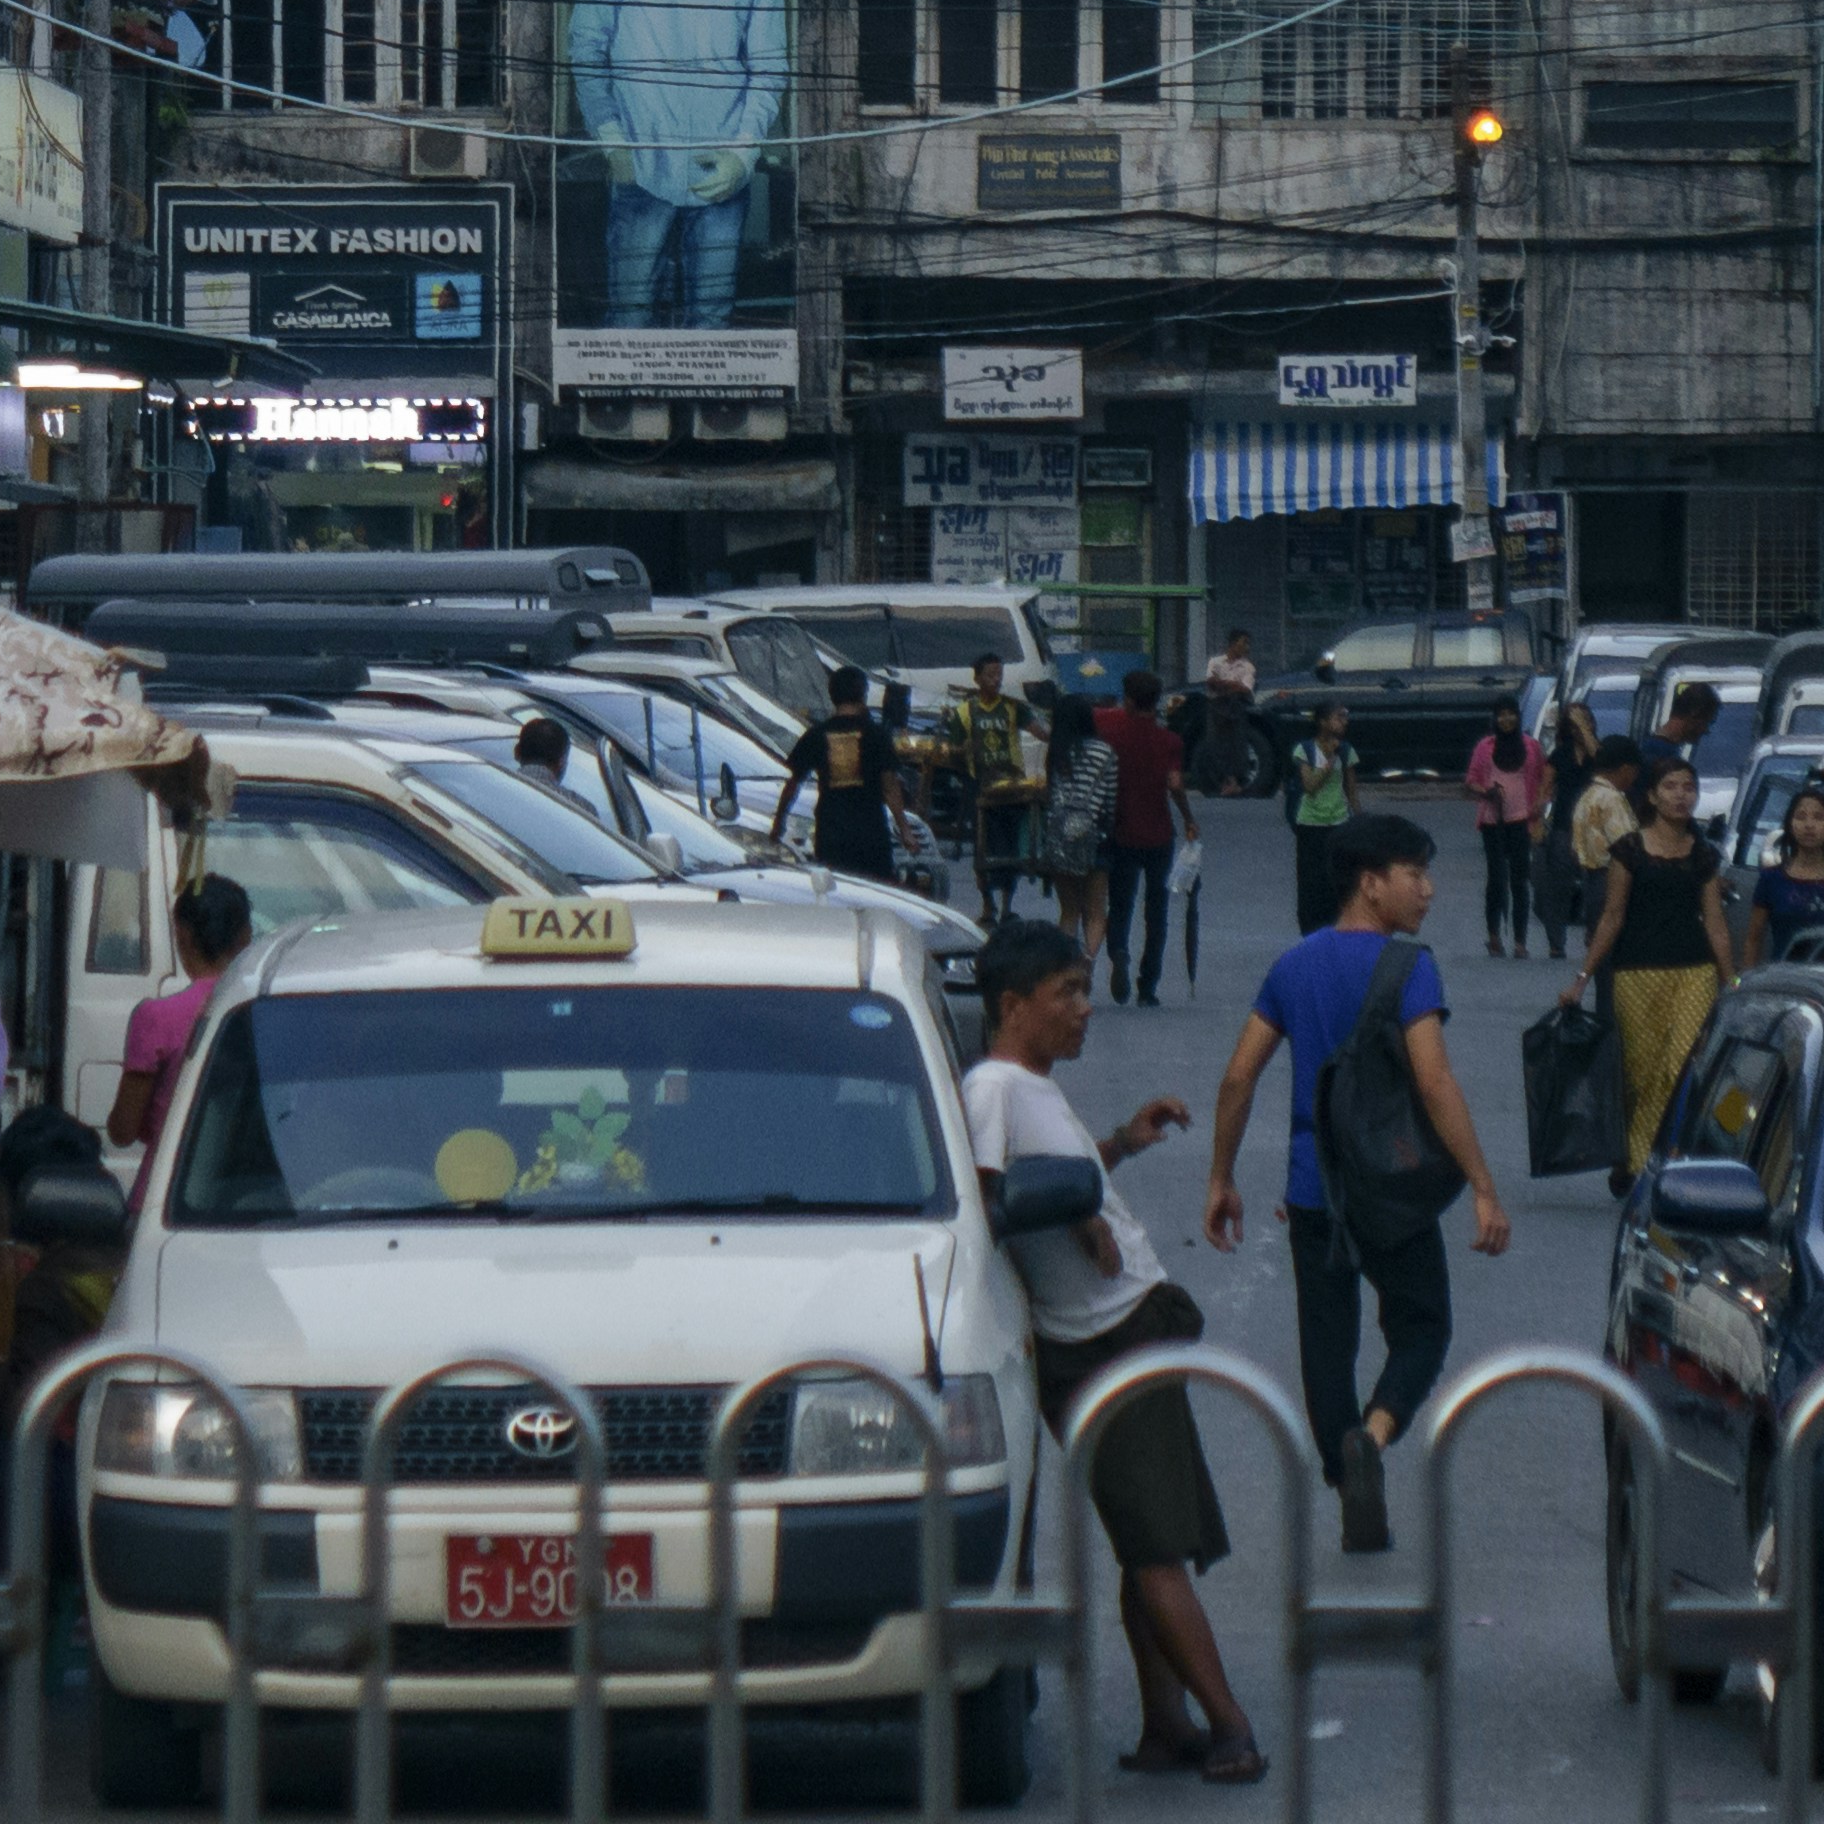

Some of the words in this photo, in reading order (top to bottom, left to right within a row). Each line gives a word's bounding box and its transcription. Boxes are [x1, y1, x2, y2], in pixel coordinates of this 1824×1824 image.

[184, 227, 318, 254] UNITEX
[330, 228, 483, 254] FASHION
[272, 312, 392, 328] CASABLANCA
[509, 908, 613, 940] TAXI
